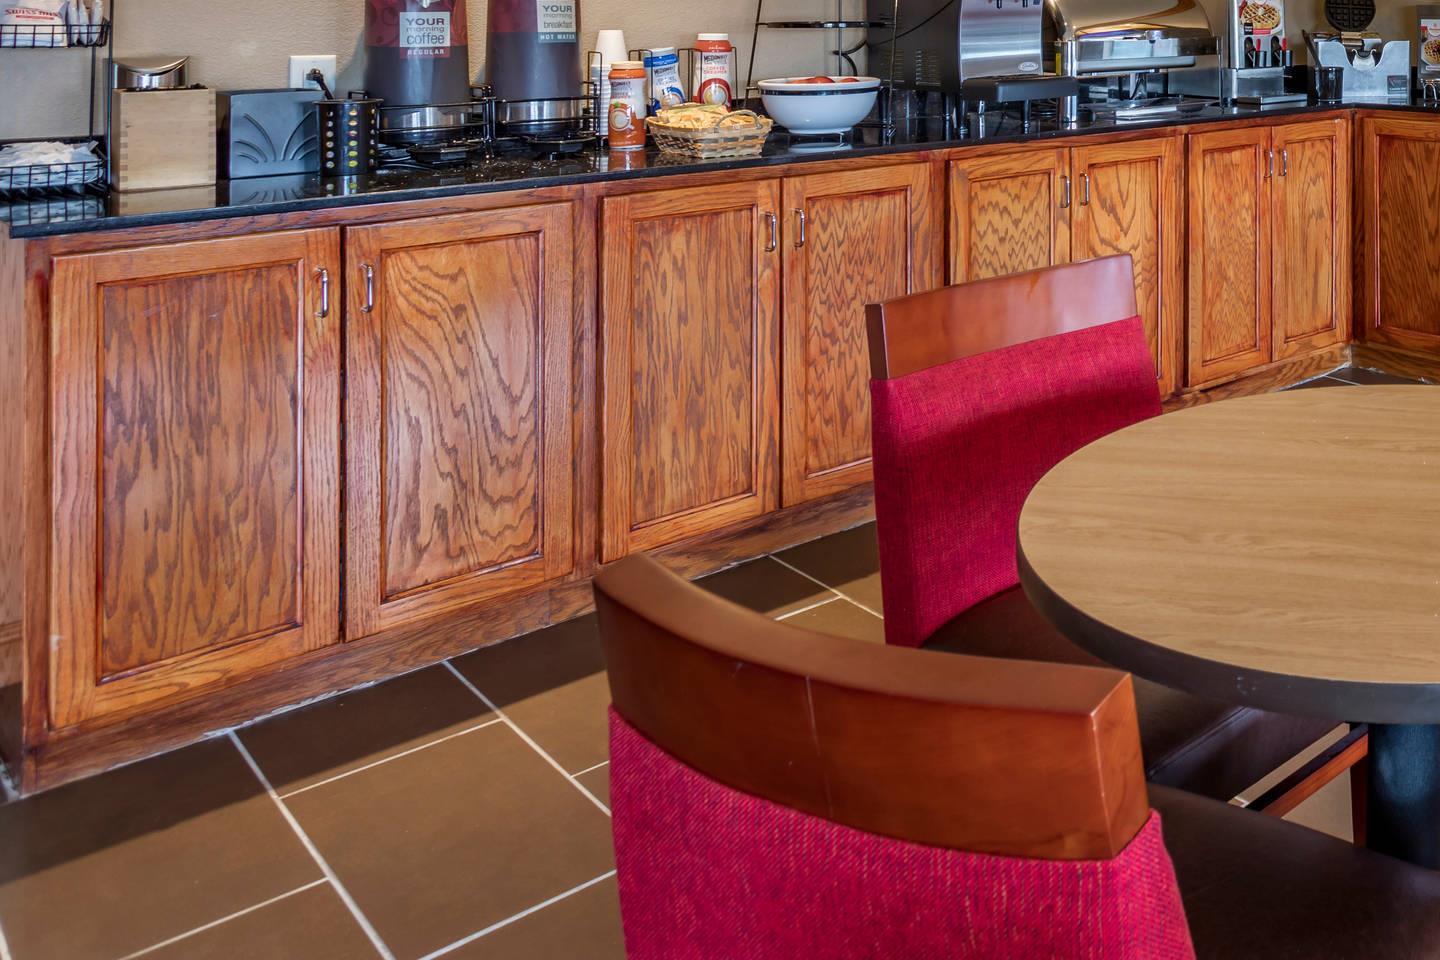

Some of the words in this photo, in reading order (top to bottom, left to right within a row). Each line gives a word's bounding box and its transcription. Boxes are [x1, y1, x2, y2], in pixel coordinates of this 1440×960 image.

[542, 4, 573, 13] YOUR
[405, 17, 445, 26] YOUR
[406, 32, 445, 45] coffee
